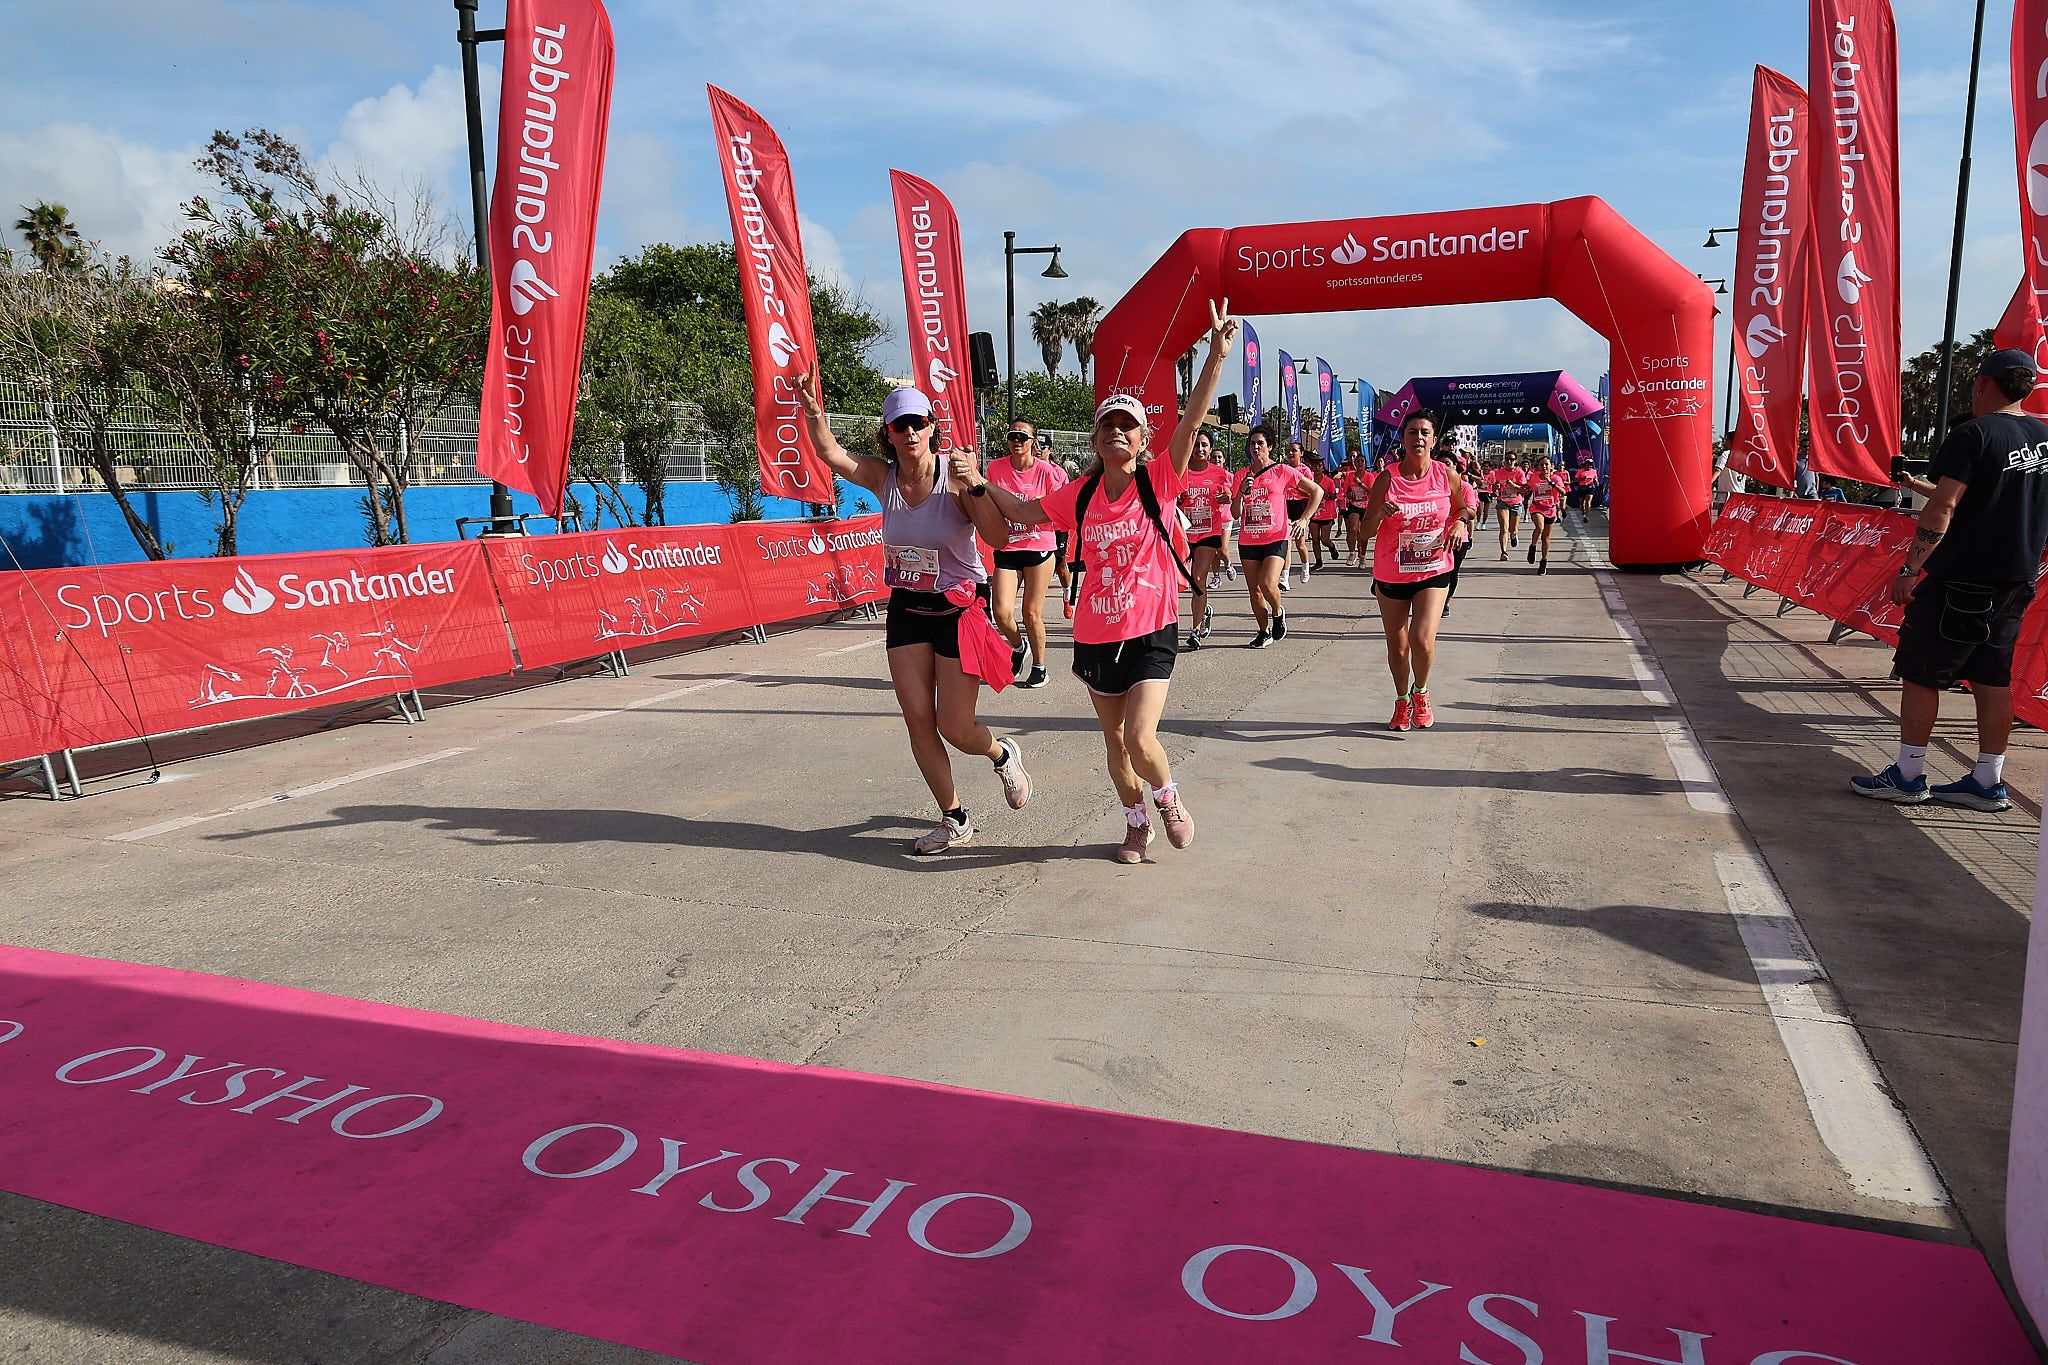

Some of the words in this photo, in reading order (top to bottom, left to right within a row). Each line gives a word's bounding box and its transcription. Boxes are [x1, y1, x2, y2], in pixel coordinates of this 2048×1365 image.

[1237, 244, 1325, 277] Sports
[1372, 227, 1530, 262] Santander
[1326, 272, 1423, 290] sportssantander.es
[1642, 355, 1689, 372] Sports
[1637, 377, 1707, 393] Santander
[1461, 406, 1541, 416] VOLVO
[1398, 501, 1439, 515] ARRERA
[1084, 518, 1140, 542] CARRERA
[756, 535, 807, 561] Sports
[826, 526, 883, 552] Santander
[1414, 549, 1432, 558] 016
[521, 551, 600, 590] Sports
[627, 541, 722, 571] Santander
[899, 570, 921, 582] 016
[57, 585, 215, 638] Sports
[279, 563, 455, 610] Santander
[1089, 592, 1136, 615] MUJER
[54, 1045, 445, 1140] OYSHO
[521, 1122, 1034, 1259] OYSHO
[1180, 1243, 1862, 1365] OYSH
